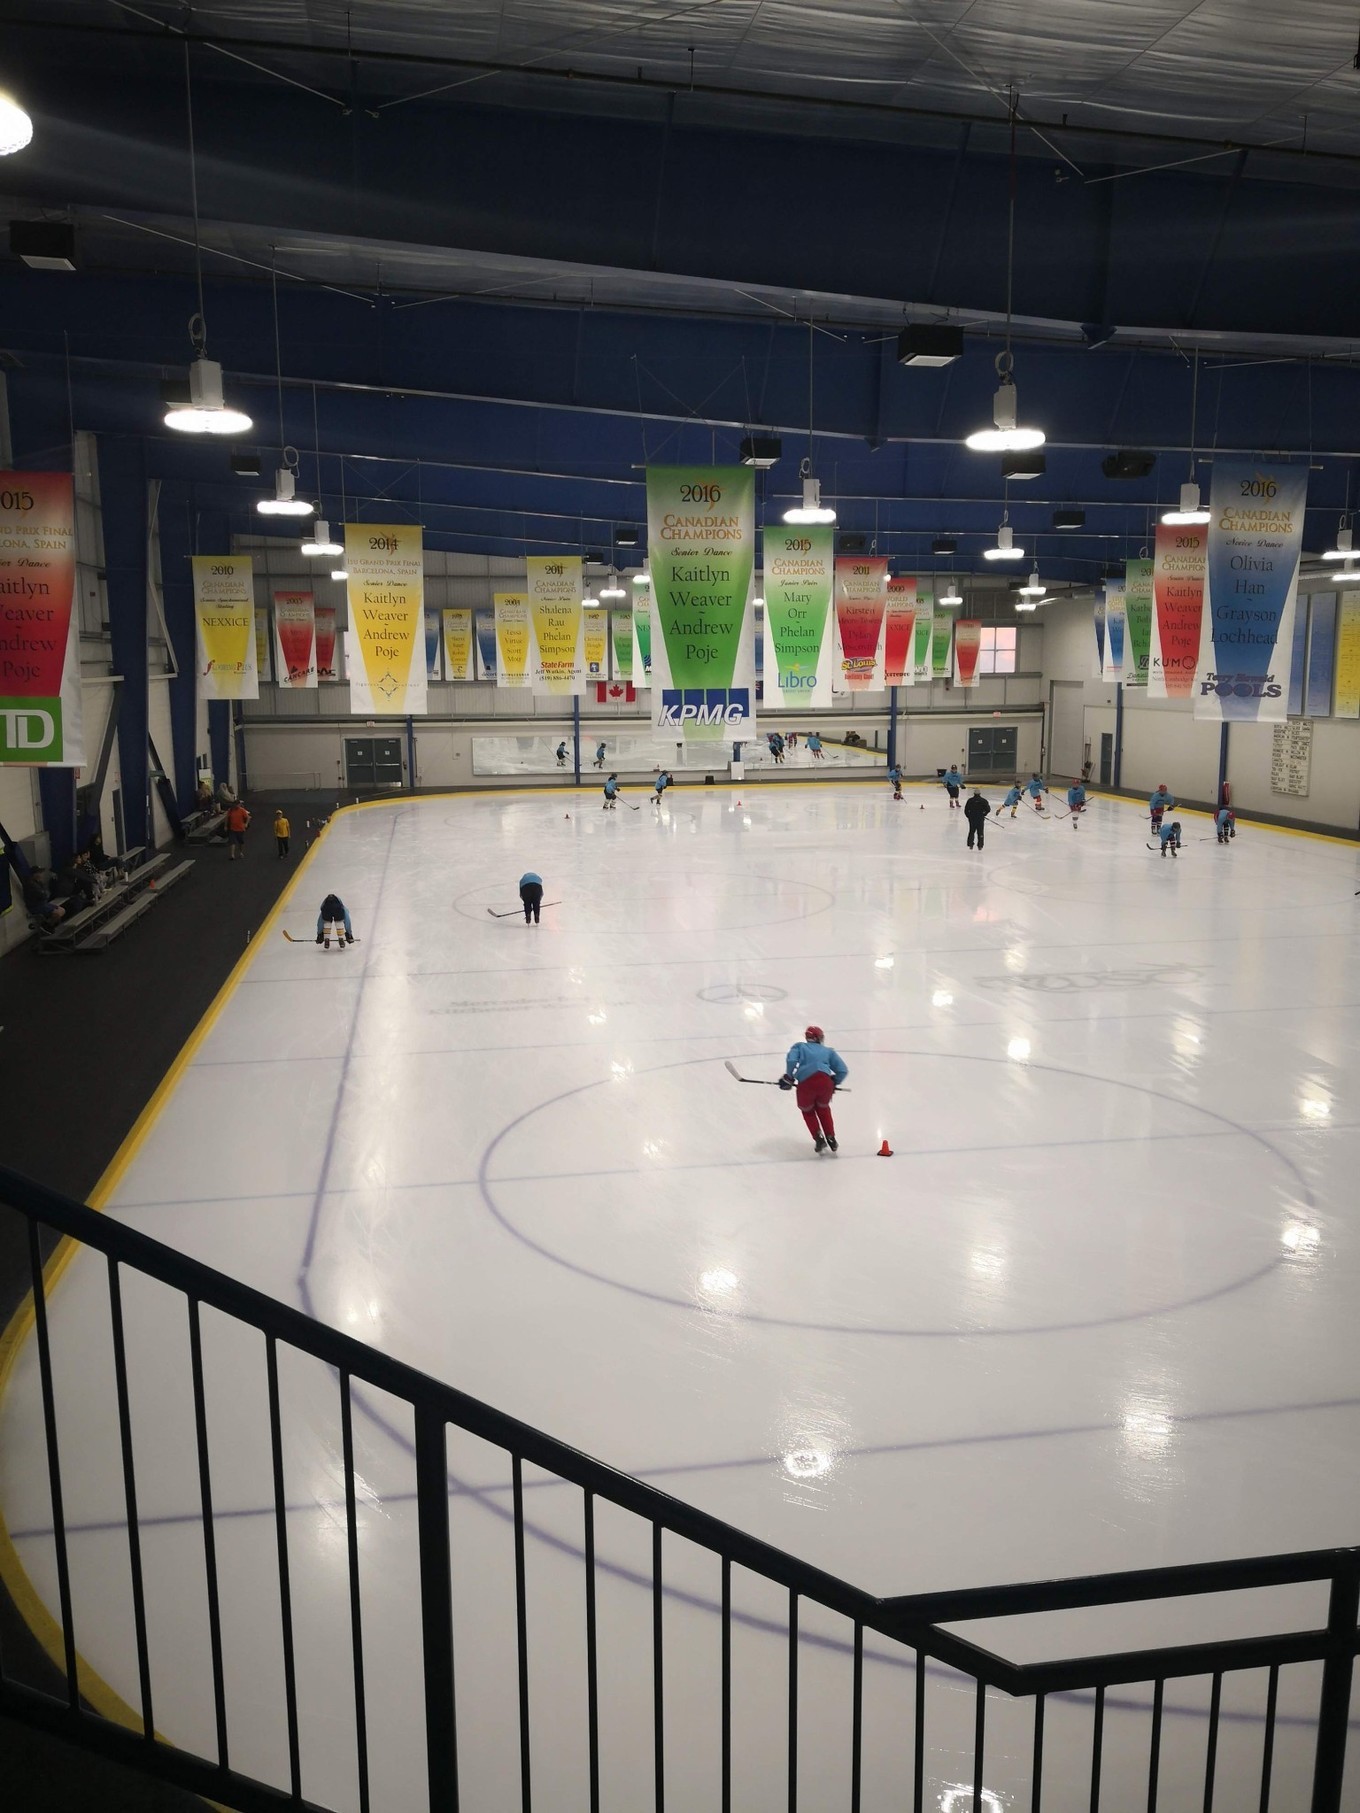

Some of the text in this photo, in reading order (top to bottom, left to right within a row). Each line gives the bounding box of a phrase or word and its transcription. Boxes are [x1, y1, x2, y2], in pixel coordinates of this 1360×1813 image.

[680, 484, 721, 502] 2016
[1240, 480, 1277, 498] 2016
[0, 491, 35, 510] 015
[1223, 507, 1291, 521] CANADIAN
[663, 514, 740, 528] CANADIAN
[1219, 518, 1293, 533] CHAMPIONS
[16, 526, 40, 536] PRIX
[43, 526, 73, 536] FINAL
[661, 527, 742, 540] CHAMPIONS
[34, 539, 66, 549] SPAIN
[368, 537, 399, 550] 2014
[785, 538, 812, 551] 2015
[1176, 536, 1200, 549] 2015
[1225, 537, 1284, 548] Novice Dance
[671, 547, 733, 556] Senior Dance
[17, 558, 51, 568] Dance
[774, 558, 823, 567] CANADIAN
[1230, 555, 1273, 572] Olivia
[211, 565, 234, 575] 2010
[353, 567, 396, 575] BARCELONA,
[544, 565, 564, 575] 2011
[671, 565, 730, 587] Kaitlyn
[772, 566, 825, 575] CHAMPIONS
[852, 565, 870, 575] 2011
[0, 577, 51, 599] aitlyn
[1235, 579, 1265, 595] Han
[363, 591, 407, 607] Kaitlyn
[669, 591, 732, 607] Weaver
[784, 592, 812, 605] Mary
[1167, 587, 1202, 601] Kaitlyn
[0, 605, 55, 621] eaver
[363, 609, 409, 621] Weaver
[539, 605, 572, 614] Shalena
[787, 607, 808, 619] Orr
[1216, 605, 1277, 624] Grayson
[202, 617, 249, 627] NEXXICE
[548, 618, 565, 627] Rau
[669, 618, 734, 635] Andrew
[363, 628, 410, 640] Andrew
[543, 632, 571, 641] Phelan
[780, 626, 815, 637] Phelan
[1210, 628, 1278, 645] Lochhead
[0, 634, 56, 651] ndrew
[1171, 635, 1191, 648] Poje
[375, 645, 400, 660] Poje
[540, 645, 576, 656] Simpson
[686, 644, 719, 664] Poje
[775, 643, 820, 656] Simpson
[4, 661, 41, 683] Poje
[777, 671, 818, 688] Libro
[1200, 682, 1282, 698] POOLS
[657, 703, 744, 727] KPMG
[0, 709, 55, 748] TD
